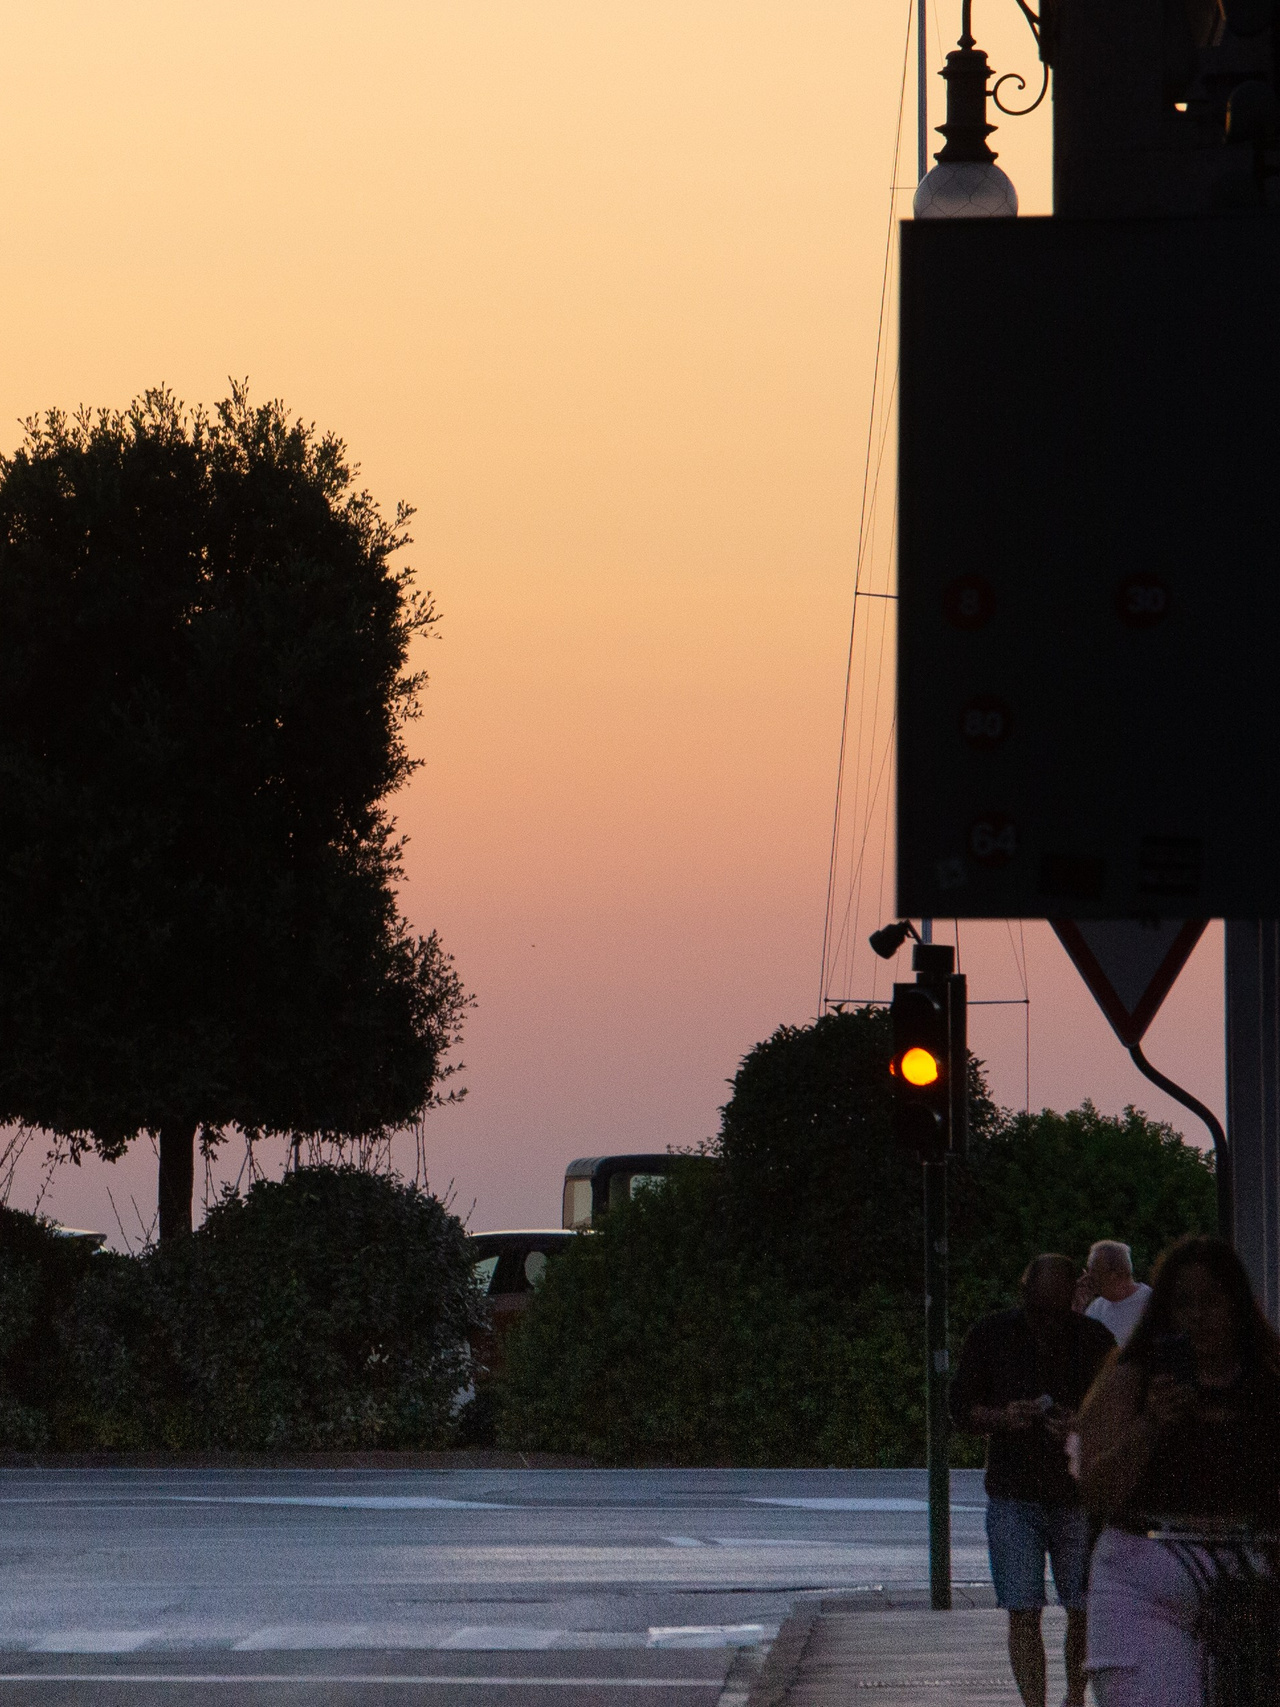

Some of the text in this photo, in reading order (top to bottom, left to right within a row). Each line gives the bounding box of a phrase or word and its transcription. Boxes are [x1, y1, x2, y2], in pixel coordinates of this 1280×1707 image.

[960, 588, 980, 616] 8
[1127, 585, 1167, 614] 30
[971, 821, 1018, 856] 64
